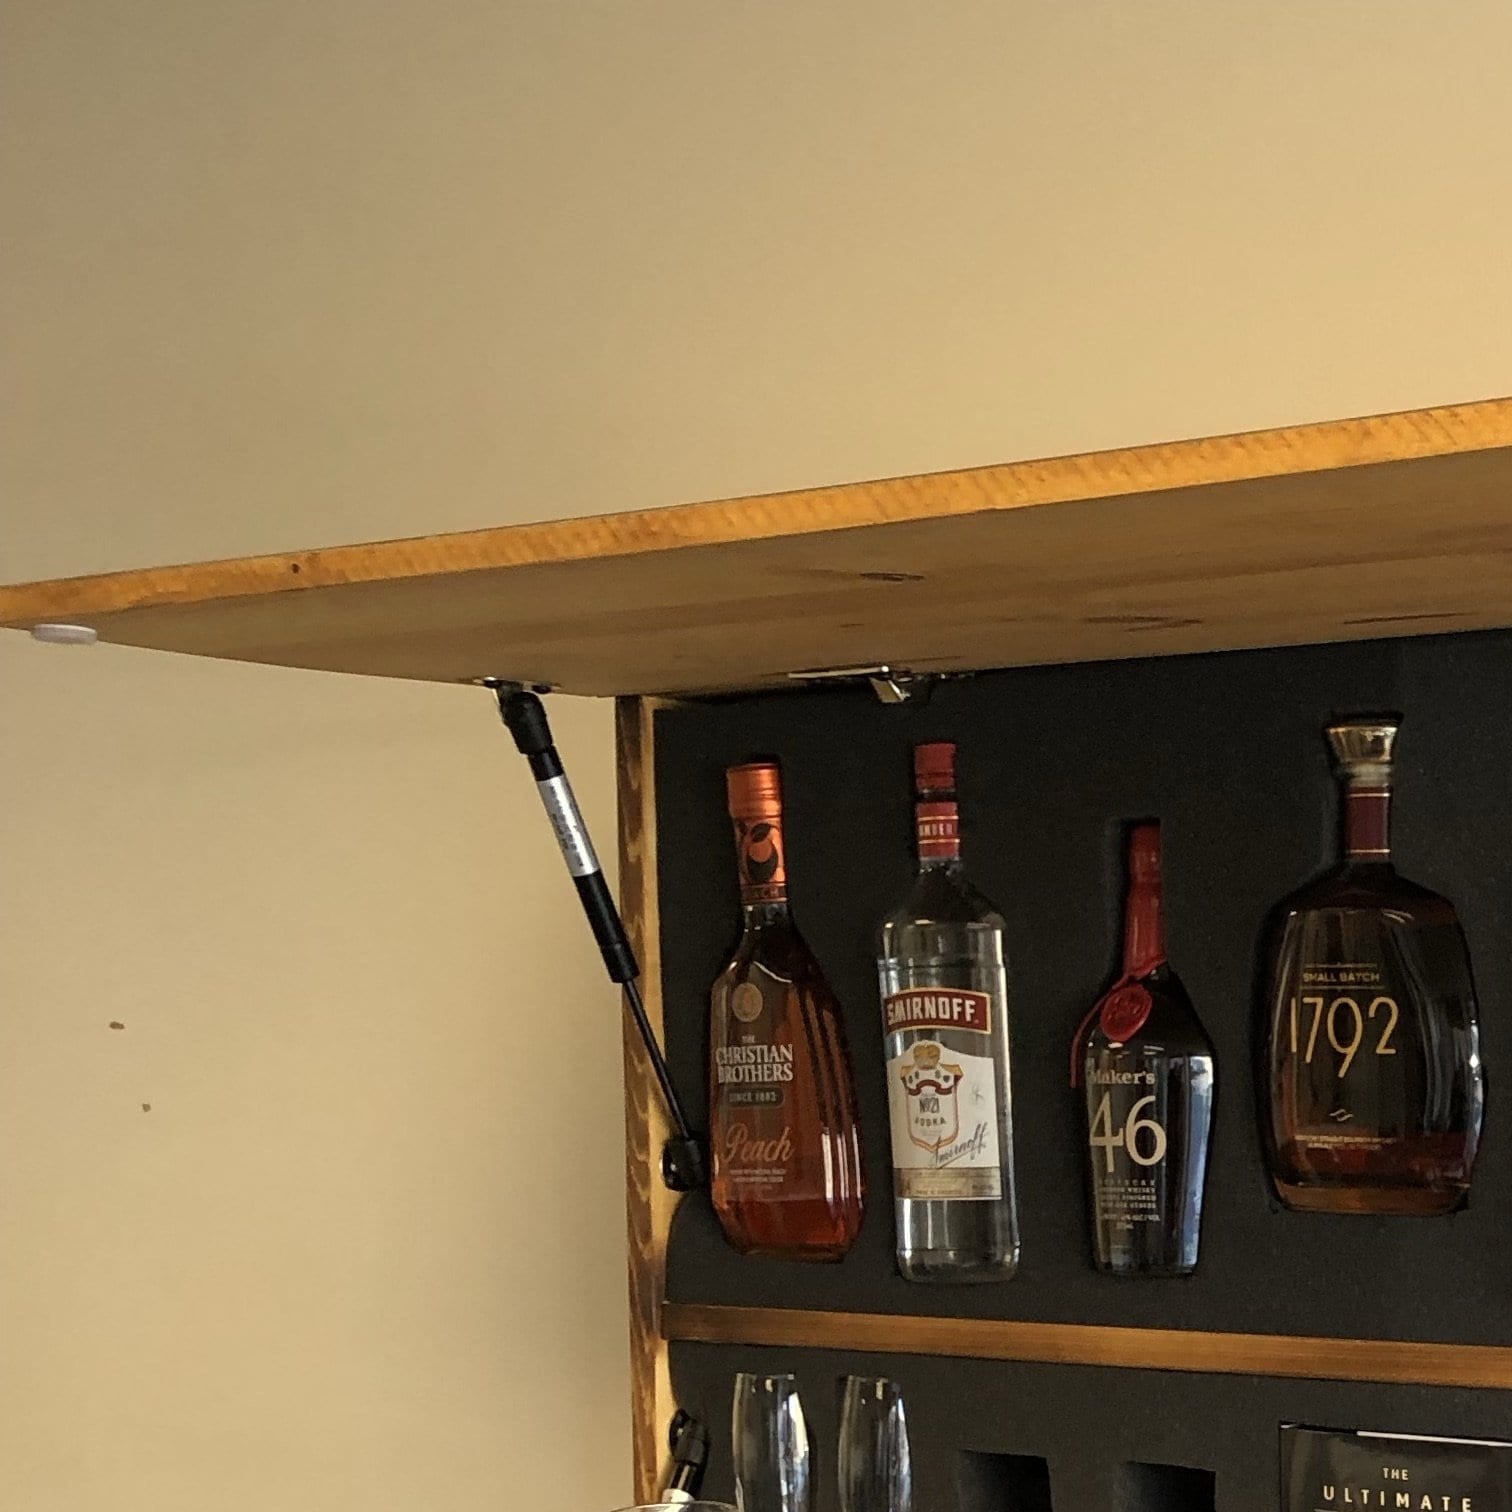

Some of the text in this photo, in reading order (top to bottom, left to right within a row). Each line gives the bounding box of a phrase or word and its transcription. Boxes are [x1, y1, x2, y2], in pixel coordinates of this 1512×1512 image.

[1303, 972, 1380, 983] SMALL BATCH
[887, 995, 977, 1026] SMIRNOFF
[1291, 996, 1399, 1079] 1792
[716, 1043, 794, 1065] CHRISTIAN
[718, 1062, 794, 1083] BROTHERS
[722, 1122, 792, 1163] Peach
[1089, 1090, 1167, 1173] 46
[1382, 1466, 1410, 1481] THE
